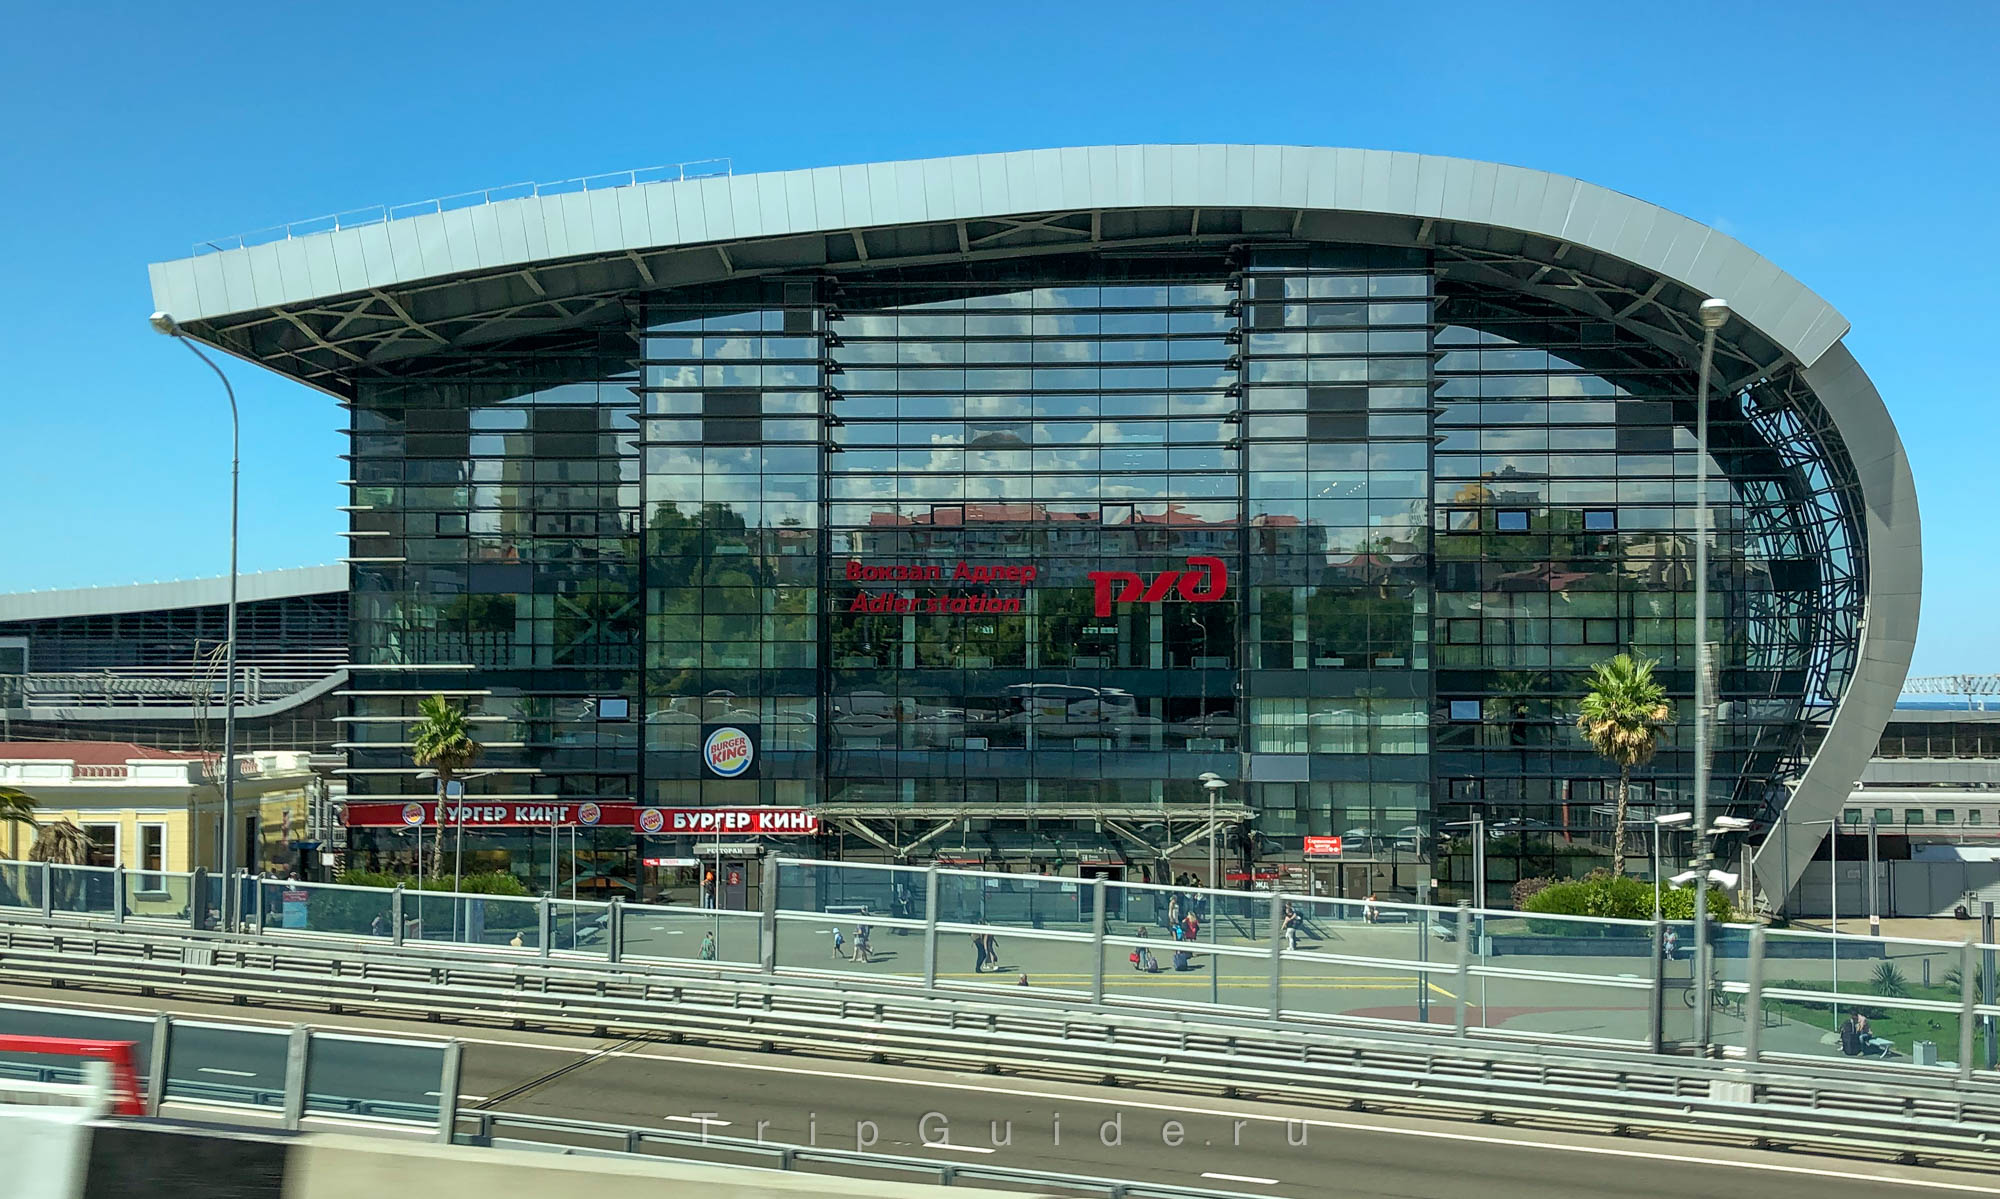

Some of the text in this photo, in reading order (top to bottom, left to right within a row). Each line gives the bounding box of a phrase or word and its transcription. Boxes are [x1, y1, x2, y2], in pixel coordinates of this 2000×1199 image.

[845, 561, 1038, 586] Вокзал Адлер
[849, 592, 1020, 613] Adler station
[711, 737, 746, 754] BURGER
[712, 745, 747, 765] KING
[515, 806, 569, 821] КИНГ
[673, 812, 751, 828] БУРГЕР
[759, 812, 817, 829] КИНГ
